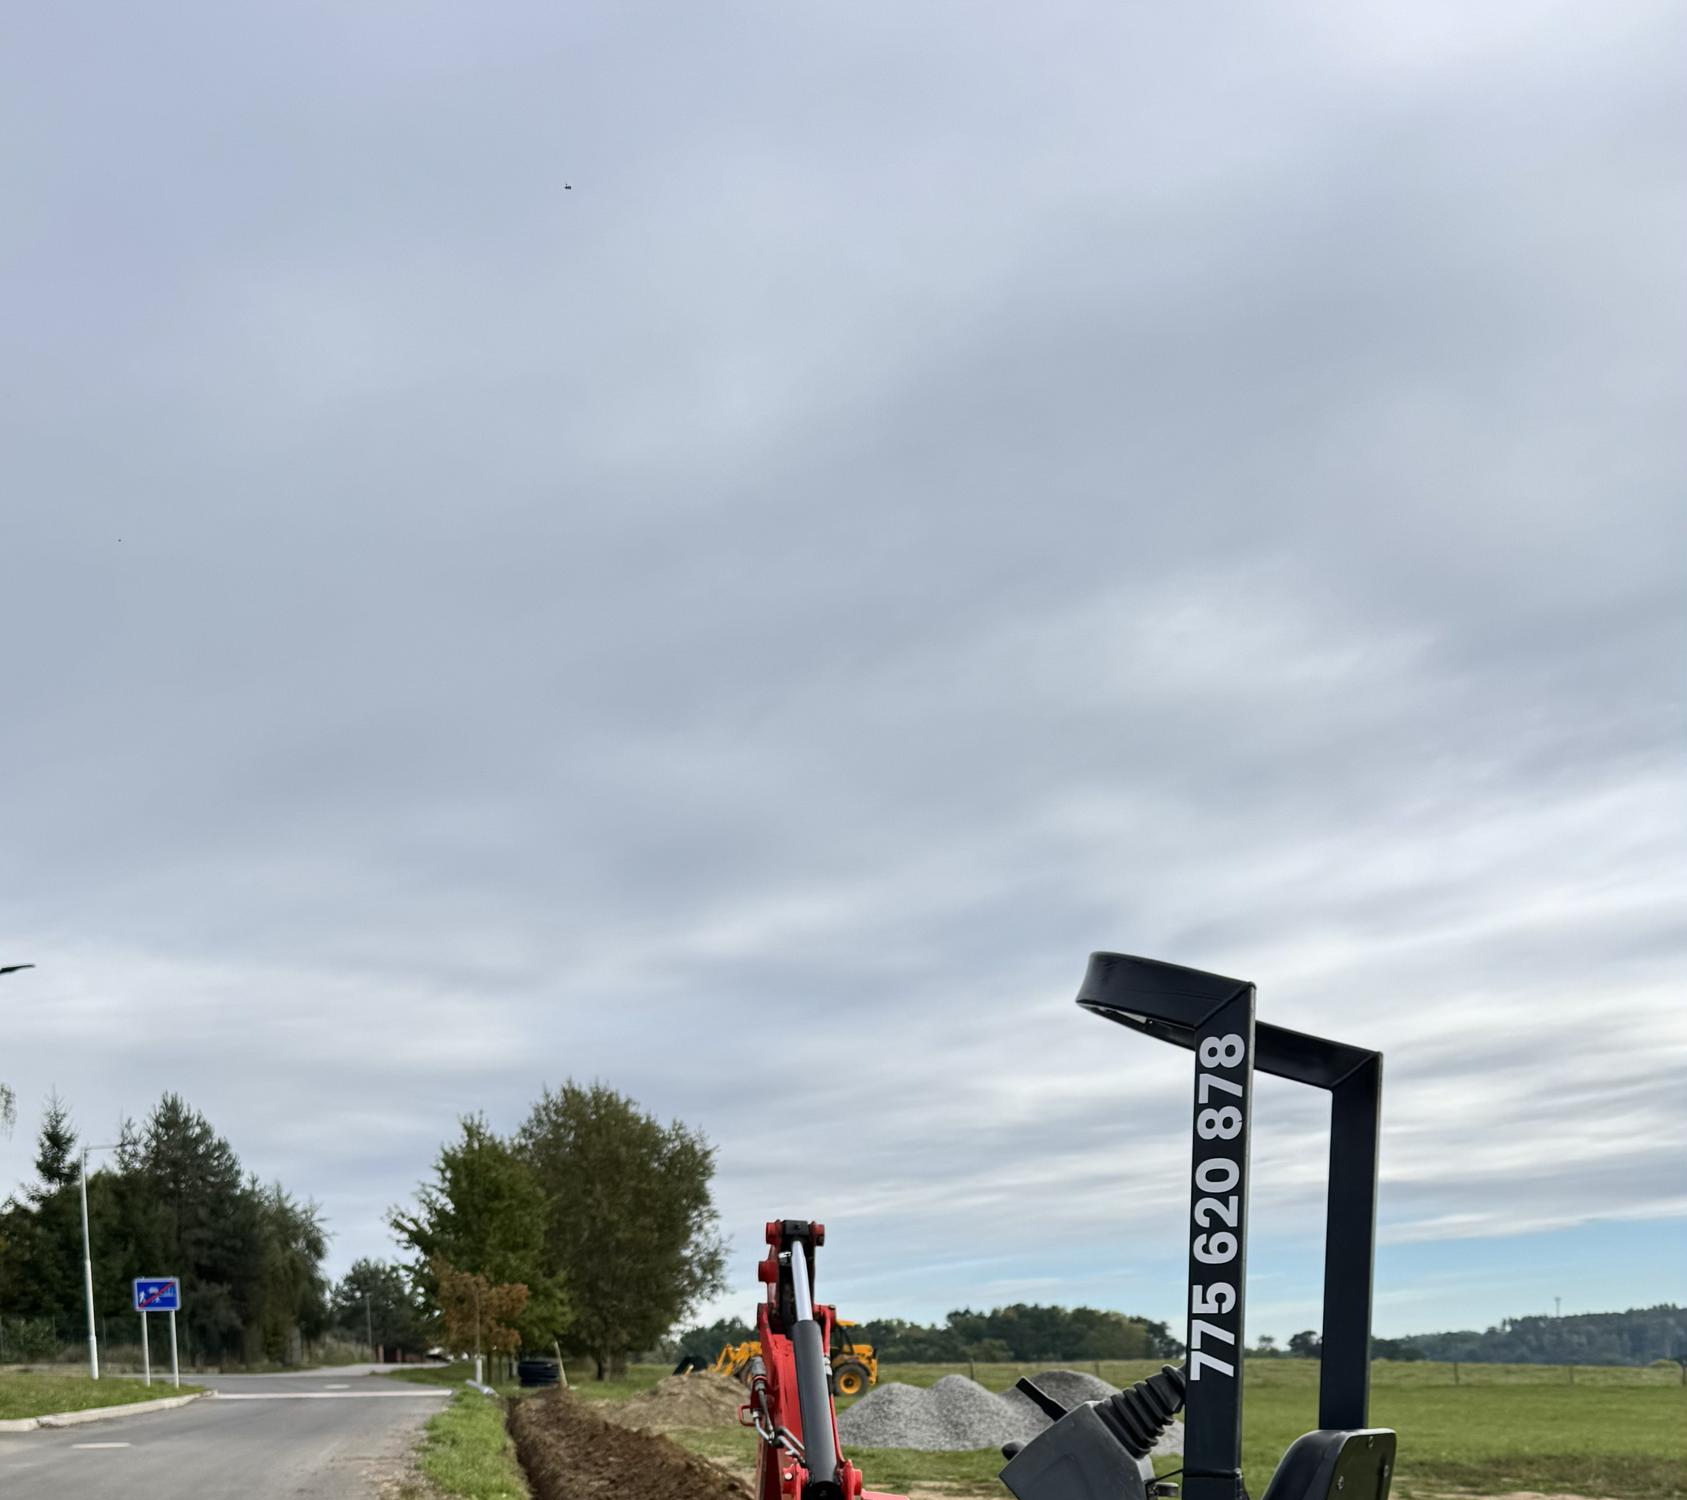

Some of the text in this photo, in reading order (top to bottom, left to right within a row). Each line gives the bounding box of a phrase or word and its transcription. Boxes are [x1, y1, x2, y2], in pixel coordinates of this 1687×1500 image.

[1189, 1033, 1246, 1381] 775 620 878
